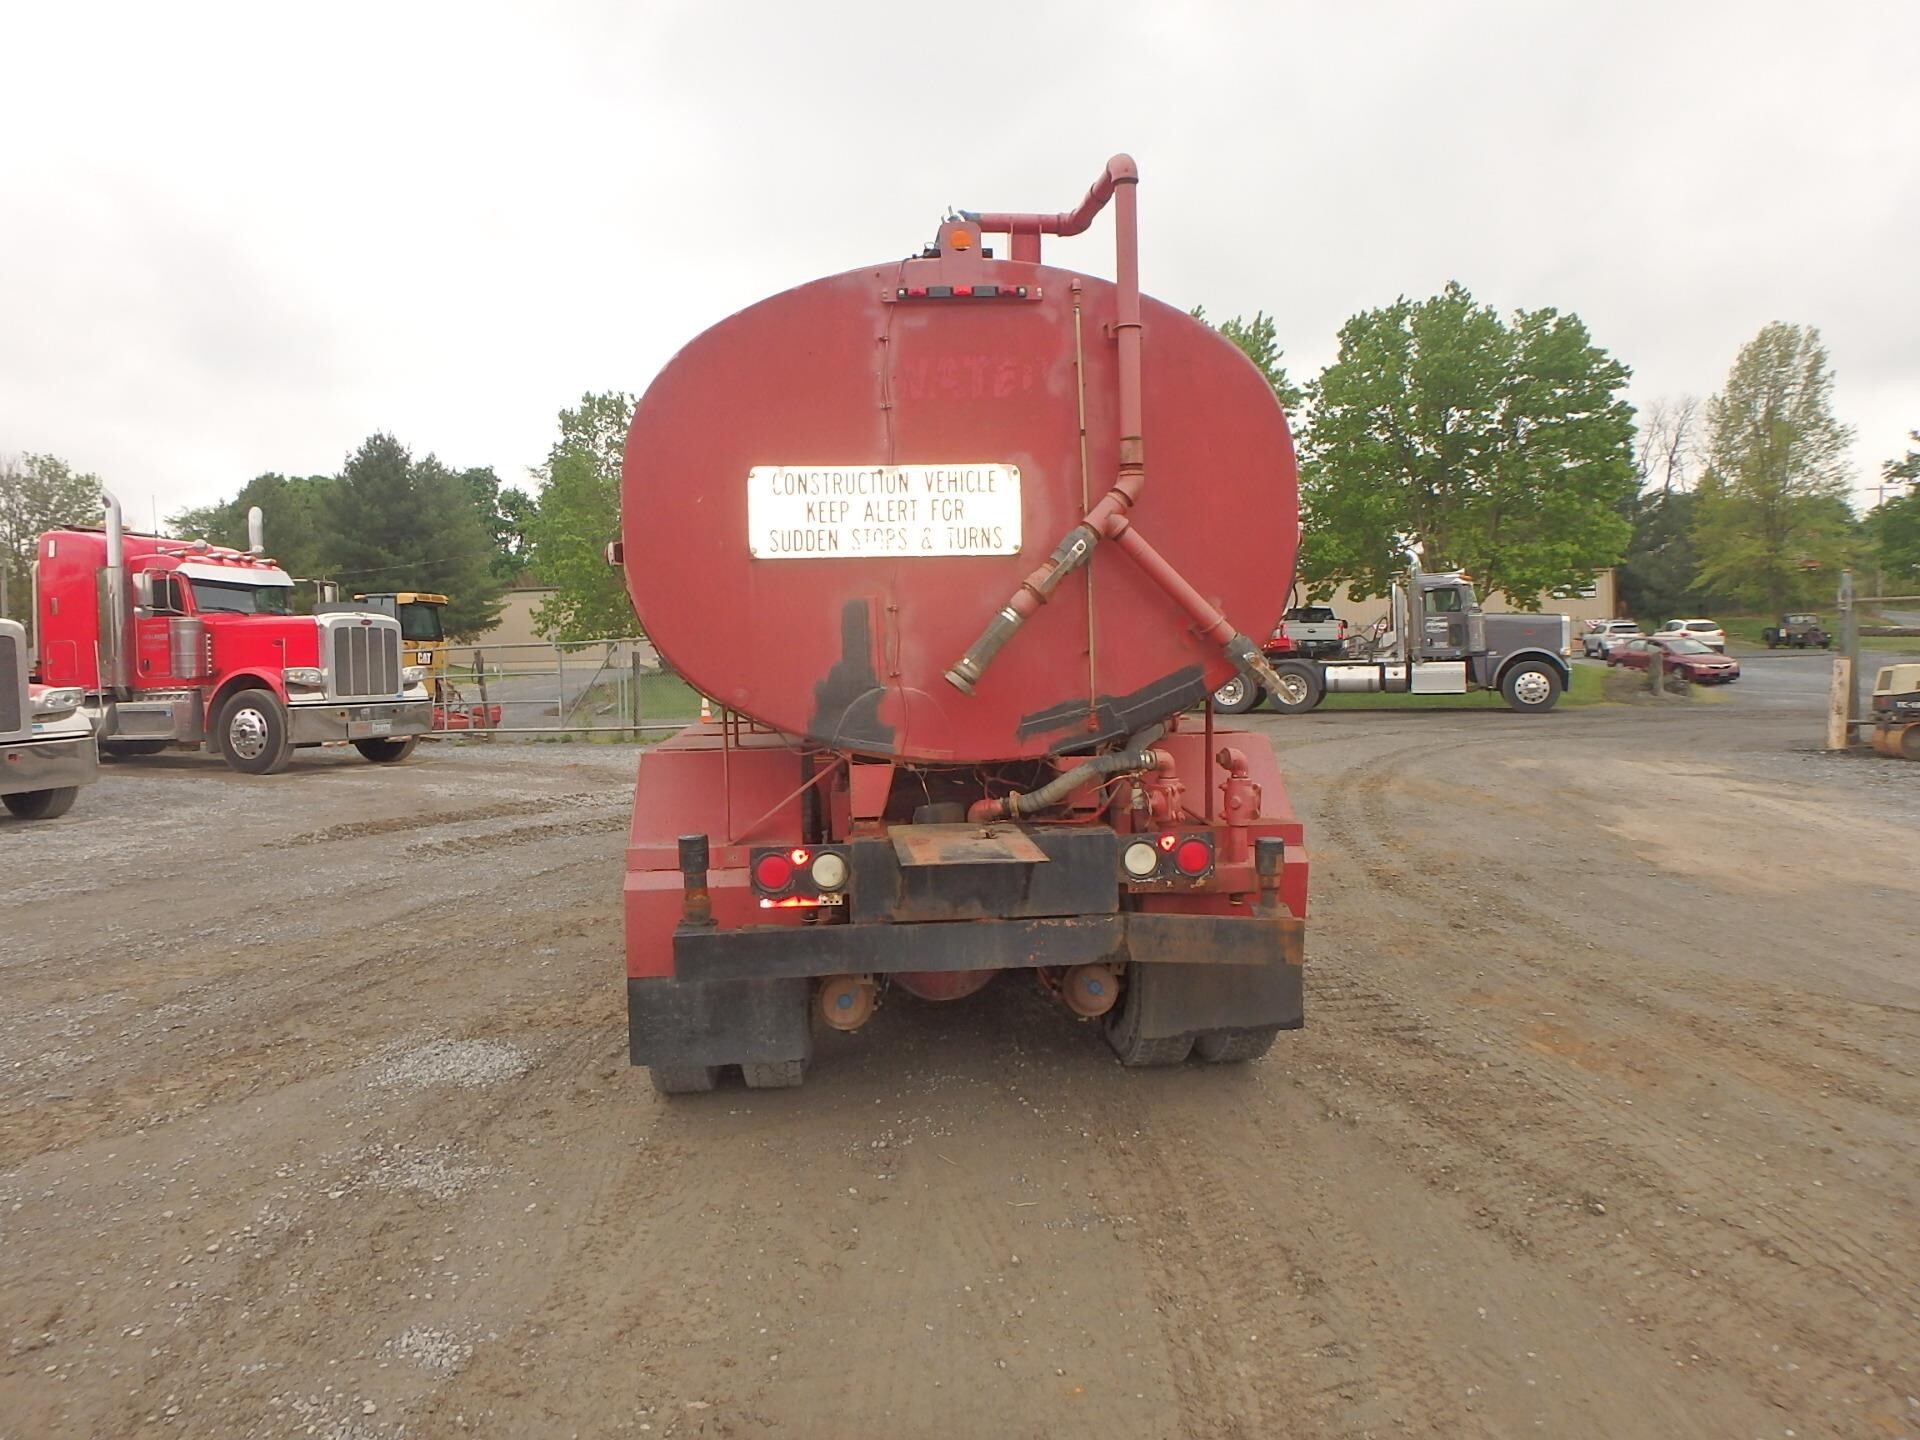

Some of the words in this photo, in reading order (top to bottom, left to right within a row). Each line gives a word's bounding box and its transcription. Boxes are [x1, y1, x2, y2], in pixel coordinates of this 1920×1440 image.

[772, 472, 909, 496] CONSTRUCTION
[924, 470, 998, 494] VEHICLE
[806, 501, 850, 524] KEEP
[863, 499, 918, 523] ALERT
[931, 498, 965, 522] FOR
[770, 529, 839, 553] SUDDEN
[851, 528, 909, 551] STOPS
[947, 526, 1004, 550] TURNS
[418, 652, 431, 664] CAT
